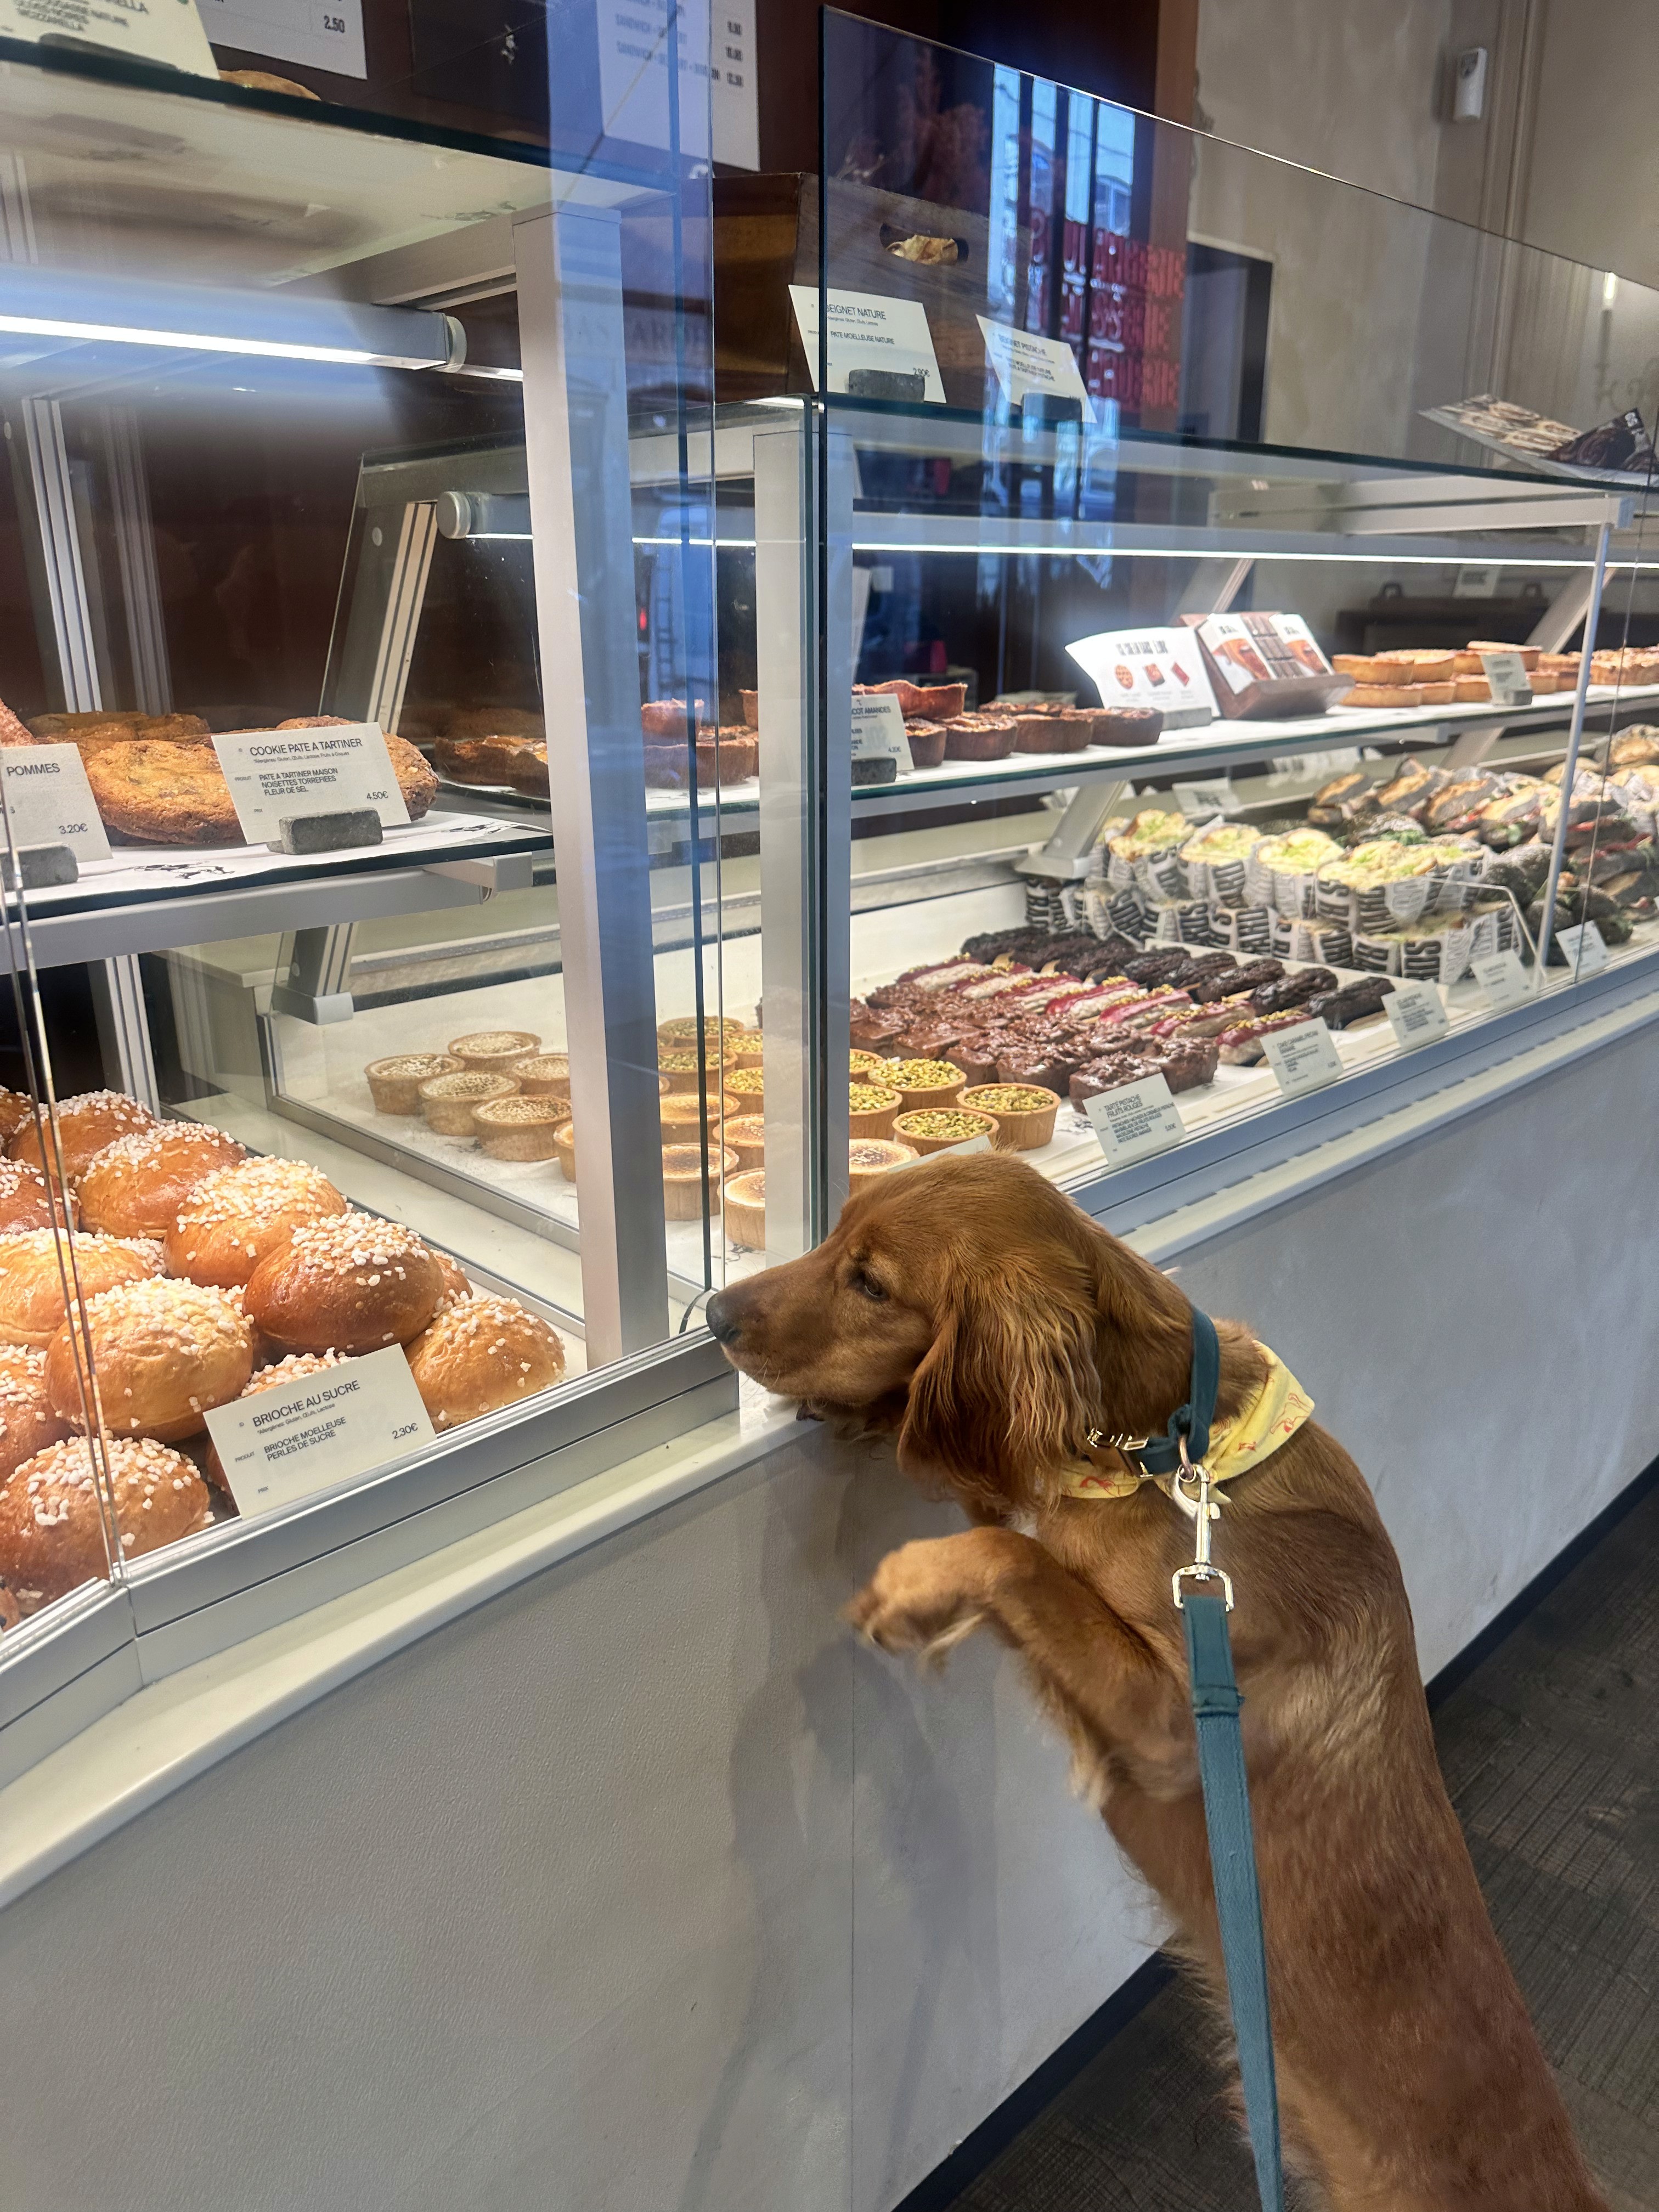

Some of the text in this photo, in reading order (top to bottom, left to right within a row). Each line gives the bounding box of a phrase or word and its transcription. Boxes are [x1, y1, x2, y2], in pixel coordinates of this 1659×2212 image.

[324, 15, 346, 33] 2.50
[857, 307, 887, 320] NATURE
[843, 332, 875, 342] MOELLEUSE
[874, 336, 895, 345] NATURE
[250, 738, 363, 756] COOKIE PATE A TARTINER
[6, 763, 60, 776] POMMES
[258, 773, 276, 781] PATE
[280, 770, 312, 779] TARTINER
[312, 768, 338, 776] MAISON
[261, 775, 337, 788] NOISETTES TORREFIEES
[264, 787, 286, 796] FLEUR
[366, 791, 389, 800] 4.50€
[59, 823, 88, 834] 3.20€
[1118, 1093, 1141, 1106] PISTACHE
[1107, 1107, 1124, 1118] FRUITS
[1123, 1100, 1143, 1112] ROUGES
[252, 1380, 360, 1427] BRIOCHE AU SUCRE
[317, 1403, 335, 1413] Lactose
[263, 1417, 347, 1454] BRIOCHE MOELLEUSE
[392, 1423, 418, 1440] 2.30€
[267, 1429, 336, 1462] PERLES DE SUCRE
[235, 1451, 255, 1462] PRODUIT
